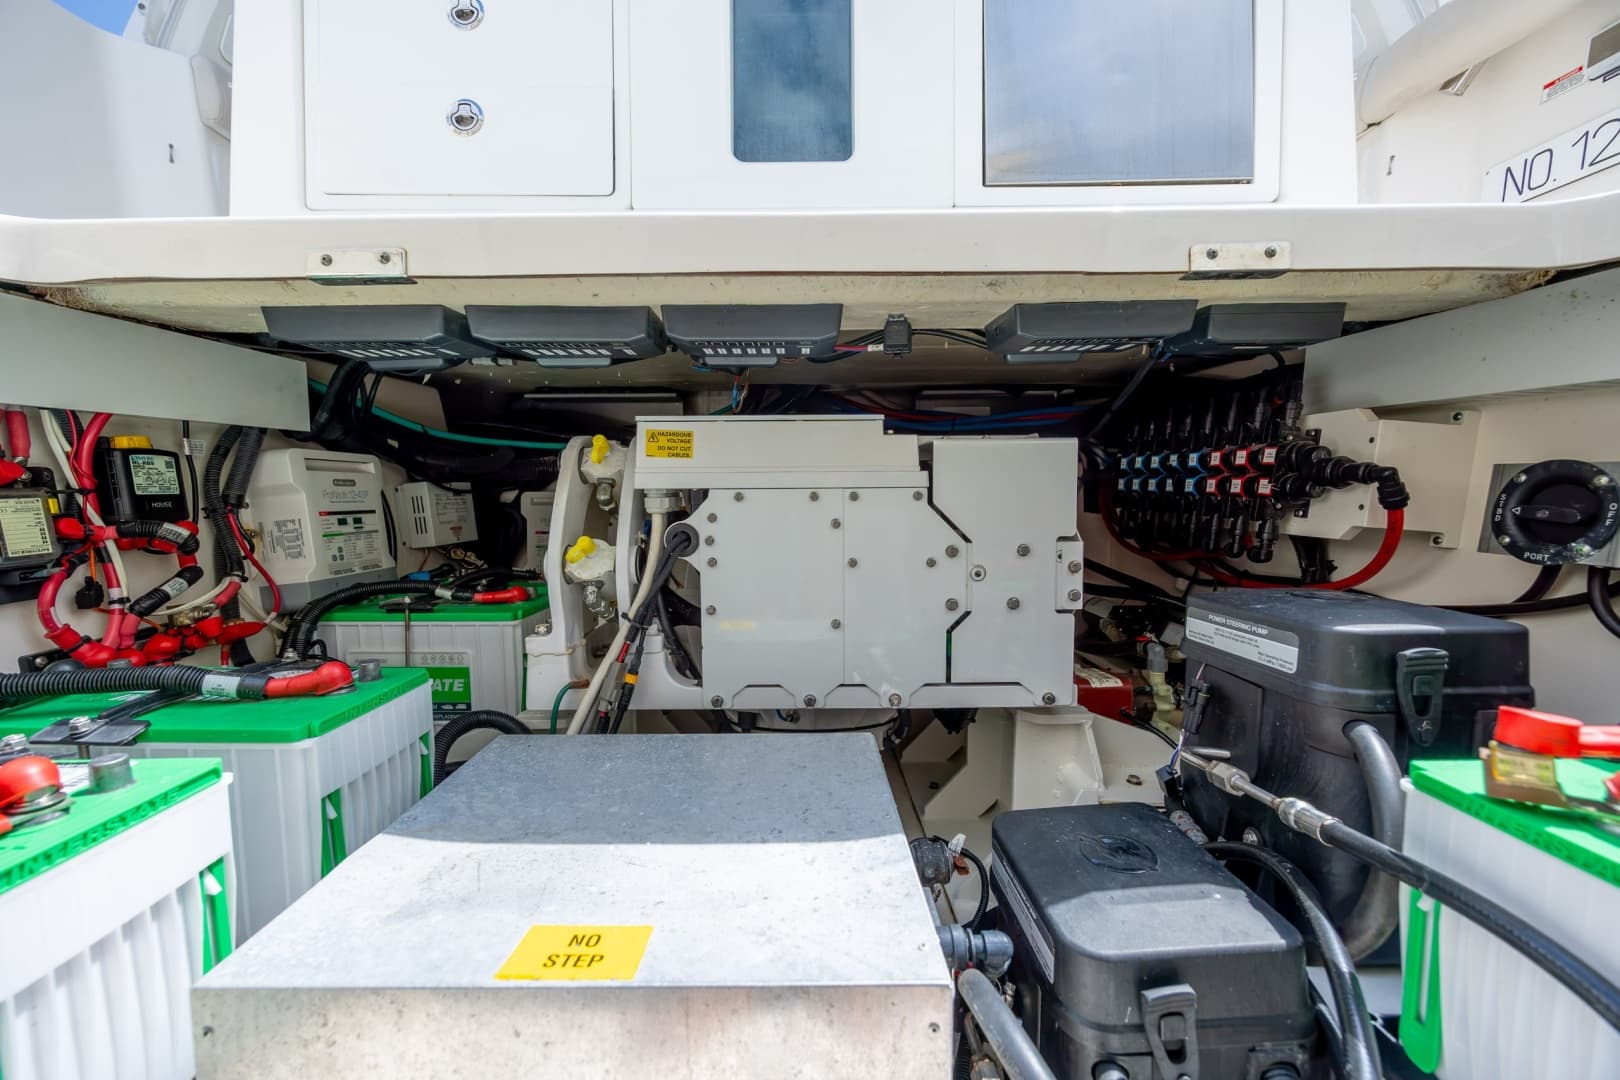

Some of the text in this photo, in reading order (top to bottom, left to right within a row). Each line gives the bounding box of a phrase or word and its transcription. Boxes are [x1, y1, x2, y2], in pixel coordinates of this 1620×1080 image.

[1501, 148, 1557, 202] NO.
[1494, 493, 1507, 522] STBD
[1605, 502, 1618, 527] OFF
[1523, 551, 1550, 562] PORT
[1208, 614, 1269, 635] POWER STEERING PUMP
[567, 933, 602, 948] NO
[542, 953, 605, 969] STEP
